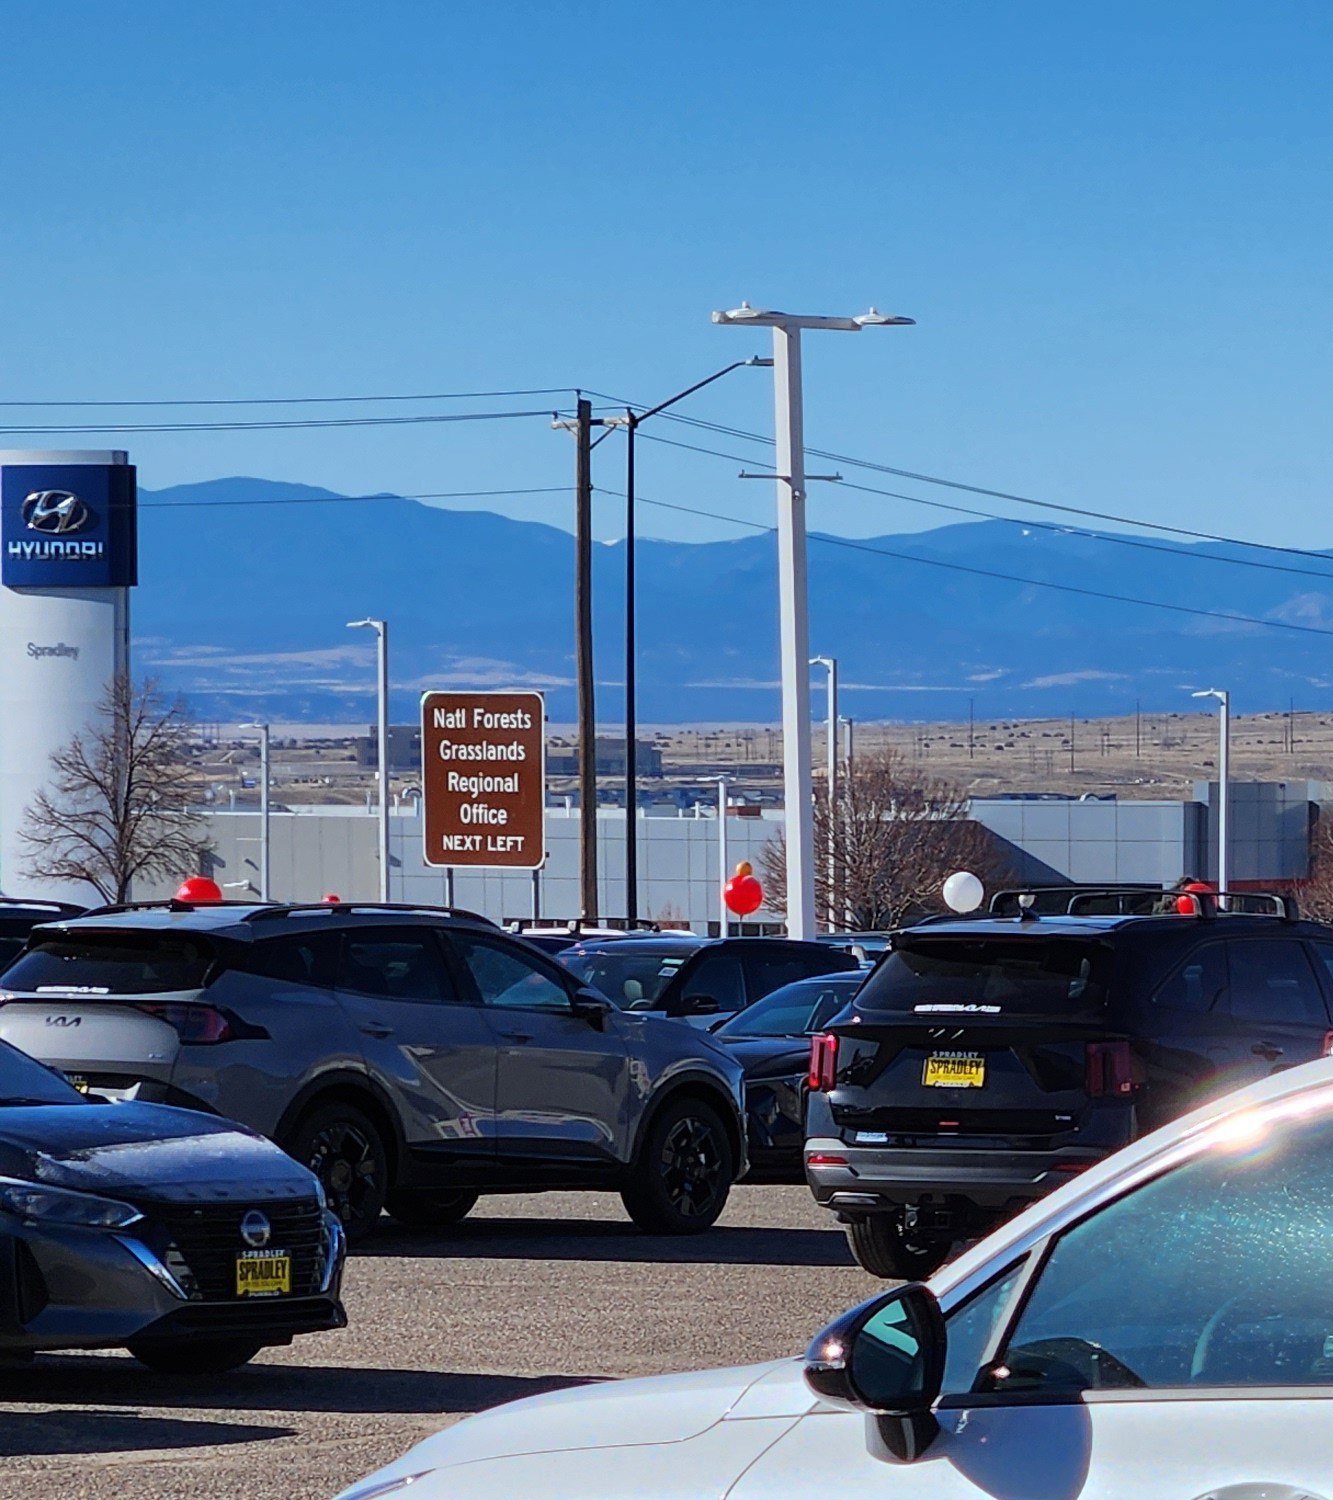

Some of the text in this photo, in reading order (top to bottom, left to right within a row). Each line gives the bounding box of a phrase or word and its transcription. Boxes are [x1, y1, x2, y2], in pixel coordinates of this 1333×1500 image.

[8, 541, 104, 560] HYUNDAI
[27, 642, 80, 661] Spradley
[433, 708, 532, 730] Natl Forests
[439, 740, 526, 761] Grasslands
[447, 772, 519, 798] Regional
[460, 803, 508, 825] Office
[442, 834, 525, 852] NEXT LEFT
[932, 1051, 979, 1059] SPRADLEY
[930, 1058, 982, 1075] SPRADLEY
[239, 1259, 287, 1282] SPRADLEY
